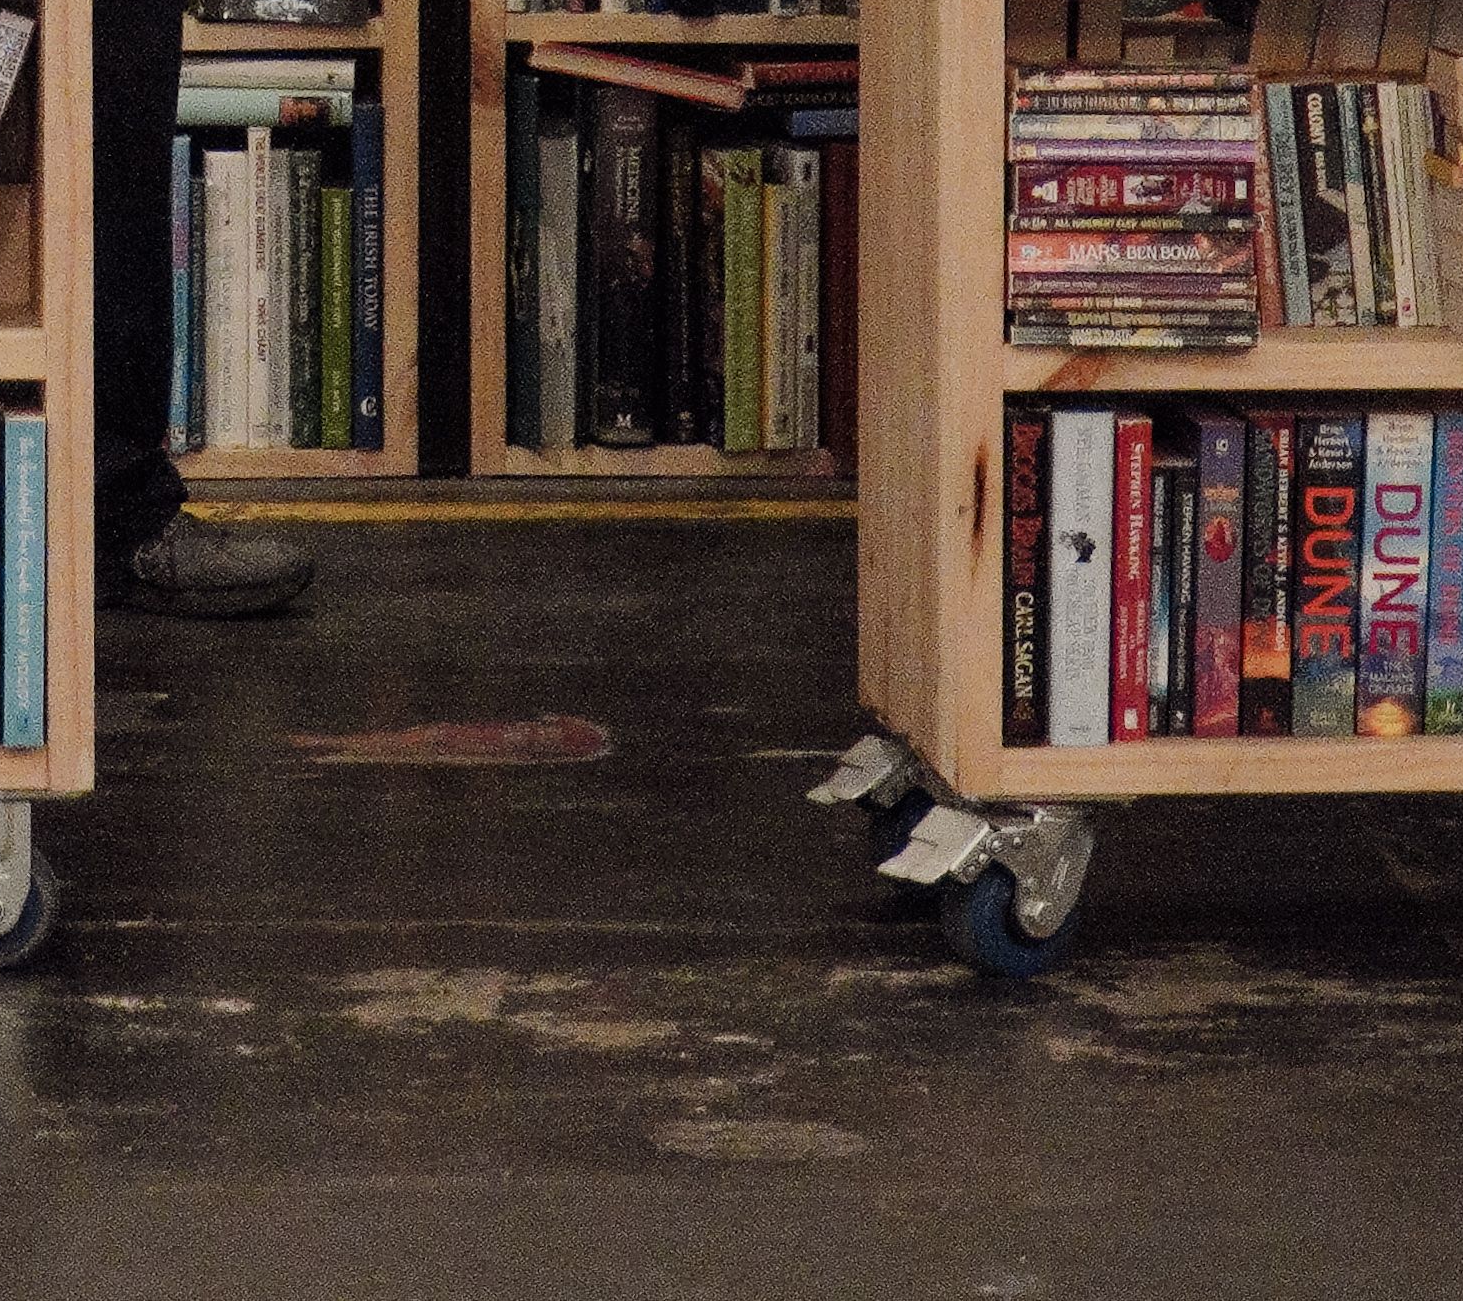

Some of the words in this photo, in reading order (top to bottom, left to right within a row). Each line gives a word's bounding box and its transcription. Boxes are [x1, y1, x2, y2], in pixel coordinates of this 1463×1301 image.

[1069, 244, 1121, 262] MARS
[1299, 486, 1356, 659] DUNE
[1371, 482, 1424, 655] DUNE
[1012, 592, 1037, 640] CARL
[1013, 645, 1036, 699] SAGAN
